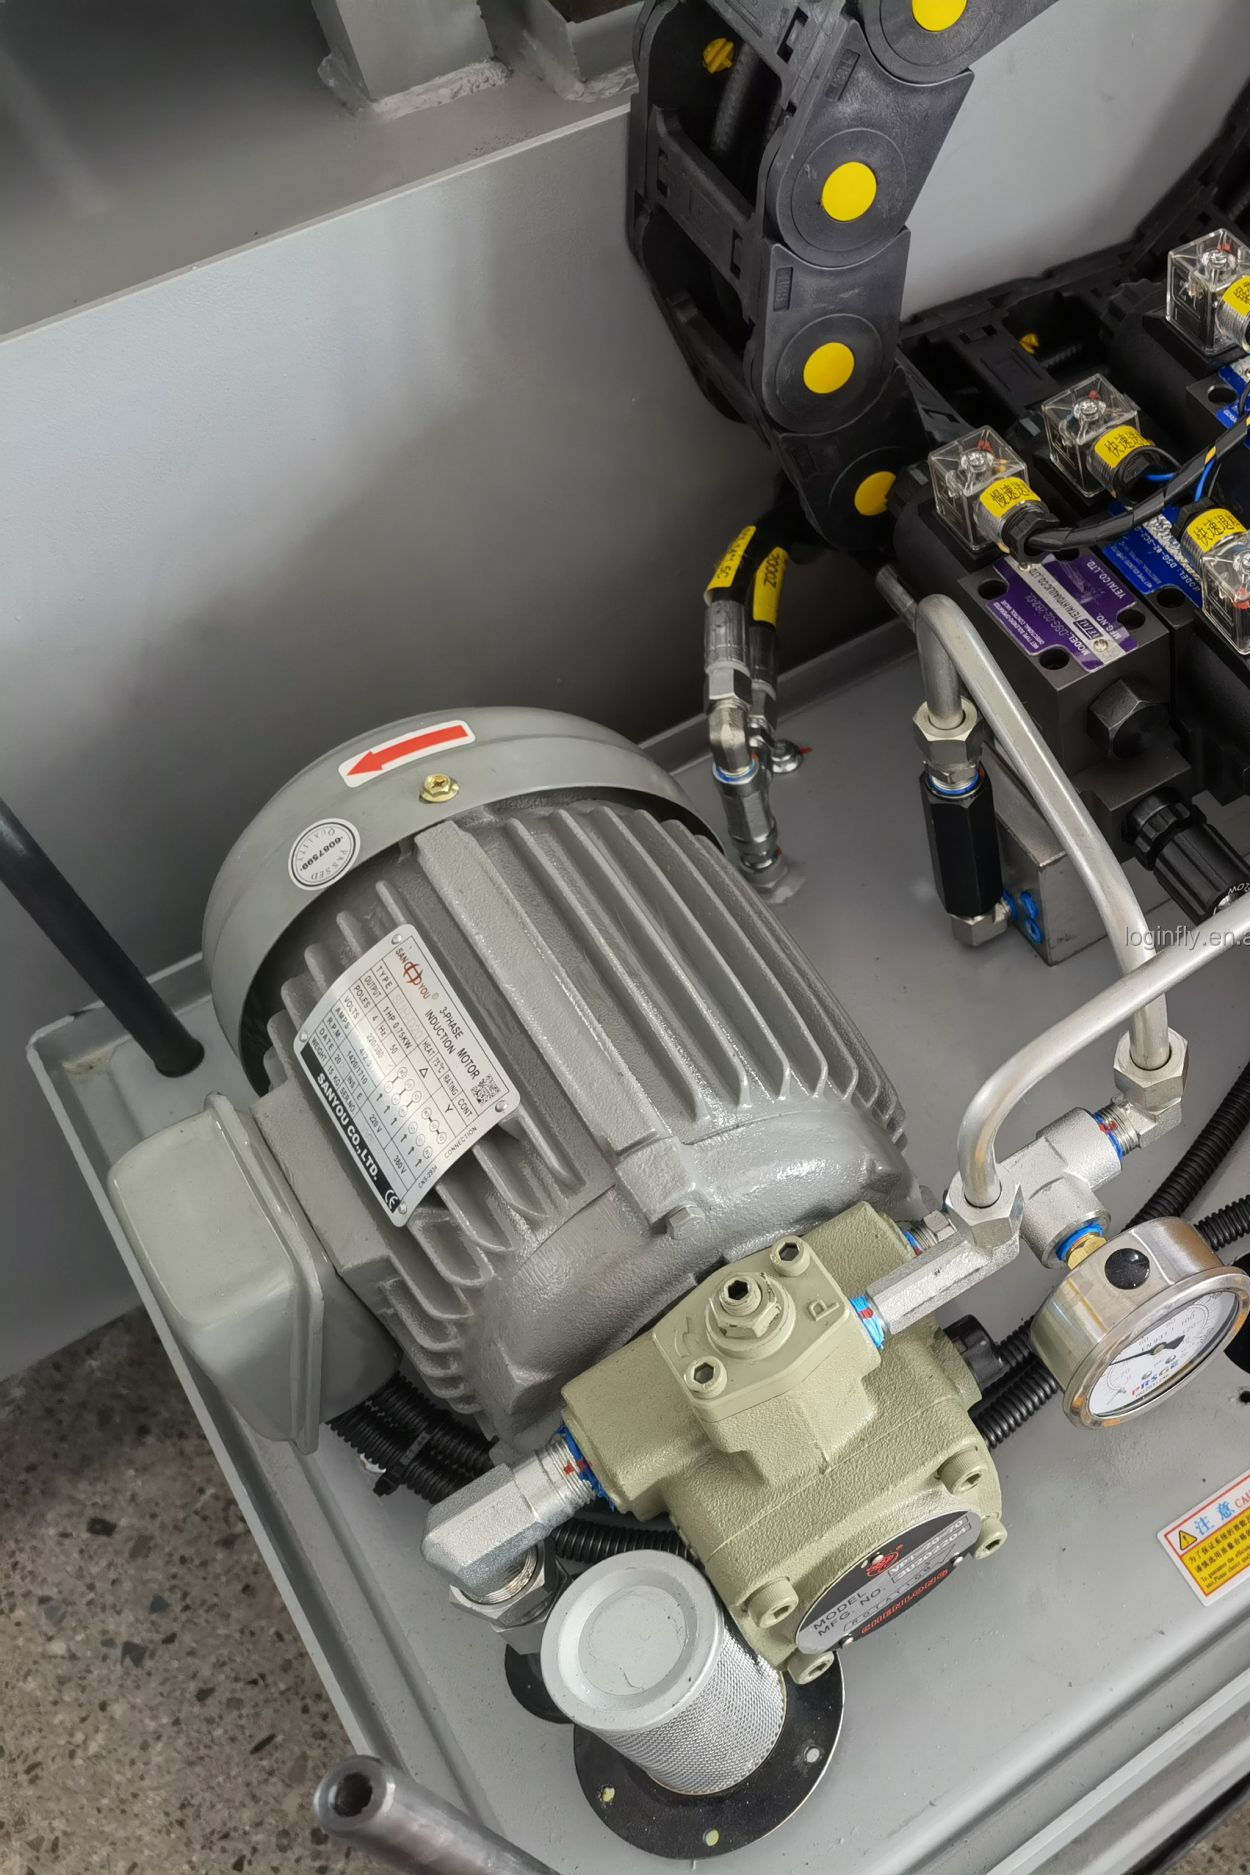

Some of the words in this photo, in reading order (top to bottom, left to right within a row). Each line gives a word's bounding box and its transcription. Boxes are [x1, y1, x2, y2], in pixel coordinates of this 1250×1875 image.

[363, 974, 381, 1000] OUTPUT
[394, 947, 408, 965] SAN
[416, 982, 431, 1001] YOU
[333, 1006, 350, 1031] AMPS
[341, 995, 360, 1021] VOLTS
[352, 984, 370, 1010] POLES
[376, 1024, 387, 1038] Hz
[437, 1004, 464, 1041] 3-PHASE
[317, 1028, 334, 1052] DATE
[374, 964, 393, 990] TYPE
[421, 1040, 434, 1058] HEAT
[442, 1073, 458, 1096] RATING
[423, 1008, 456, 1055] INDUCTION
[456, 1046, 480, 1080] MOTOR
[309, 1037, 327, 1063] WEIGHT
[315, 1071, 351, 1128] SANYOU
[808, 1298, 841, 1322] P
[813, 1590, 867, 1631] MODEL
